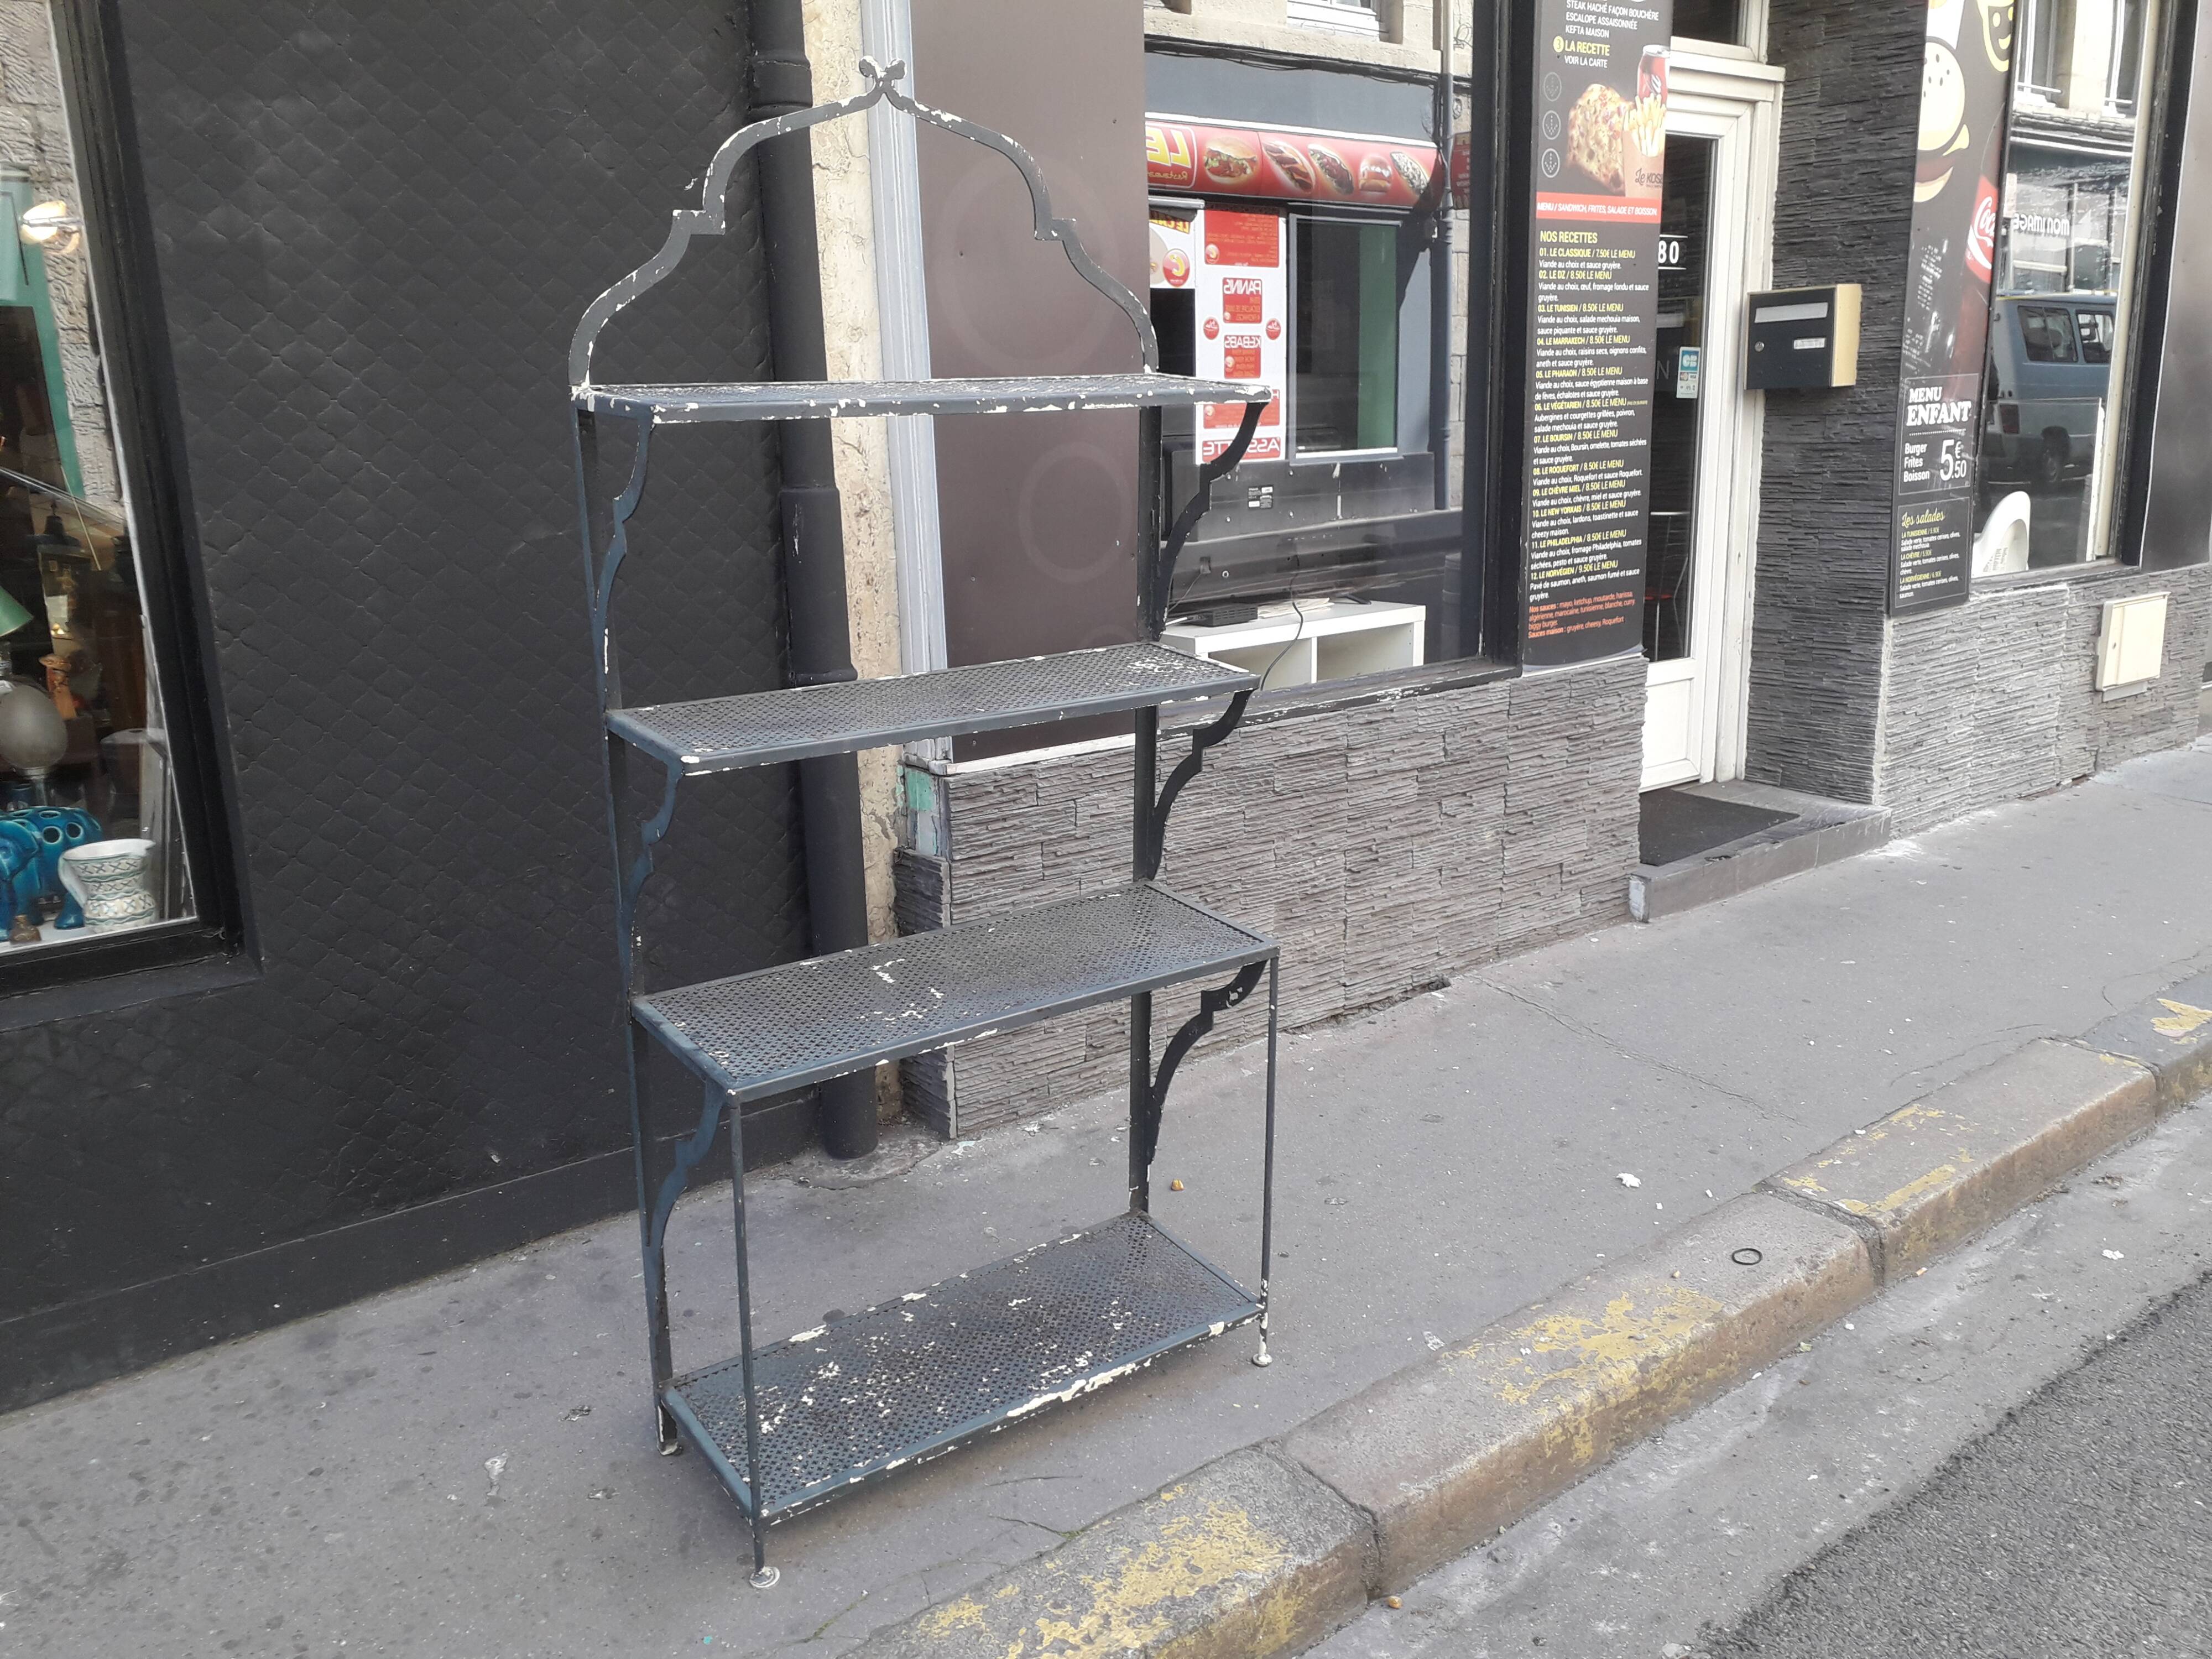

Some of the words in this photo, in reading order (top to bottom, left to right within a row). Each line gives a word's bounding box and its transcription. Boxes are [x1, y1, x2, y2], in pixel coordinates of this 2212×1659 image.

[1566, 0, 1586, 9] STEAK
[1587, 1, 1607, 13] HACHÉ
[1608, 6, 1628, 17] FAÇON
[1629, 8, 1659, 20] BOUCHÈRE
[1566, 12, 1596, 24] ESCALOPE
[1566, 25, 1584, 35] KEFTA
[1585, 28, 1609, 38] MAISON
[1565, 40, 1575, 52] LA
[1577, 41, 1610, 56] RECETTE
[1564, 55, 1579, 65] VOIR
[1580, 56, 1588, 66] LA
[1589, 58, 1608, 68] CARTE
[1627, 206, 1634, 215] ET
[1540, 230, 1557, 242] NOS
[1559, 231, 1598, 243] RECETTES
[1619, 249, 1635, 258] MENU
[1658, 240, 1679, 263] 80
[1538, 259, 1557, 268] Viande
[1595, 271, 1612, 280] MENU
[1909, 387, 1943, 403] MENU
[1610, 397, 1626, 406] MENU
[1906, 400, 1971, 426] ENFANT
[1905, 443, 1927, 456] Burger
[1607, 459, 1624, 468] MENU
[1904, 457, 1923, 469] Frites
[1532, 477, 1550, 486] Viande
[1903, 471, 1930, 482] Boisson
[1609, 479, 1625, 488] MENU
[1532, 498, 1550, 507] Viande
[1531, 519, 1549, 528] Viande
[1624, 509, 1639, 518] sauce
[1901, 512, 1914, 528] Les
[1916, 507, 1945, 524] salades
[1601, 560, 1618, 569] MENU
[1626, 568, 1640, 576] sauce
